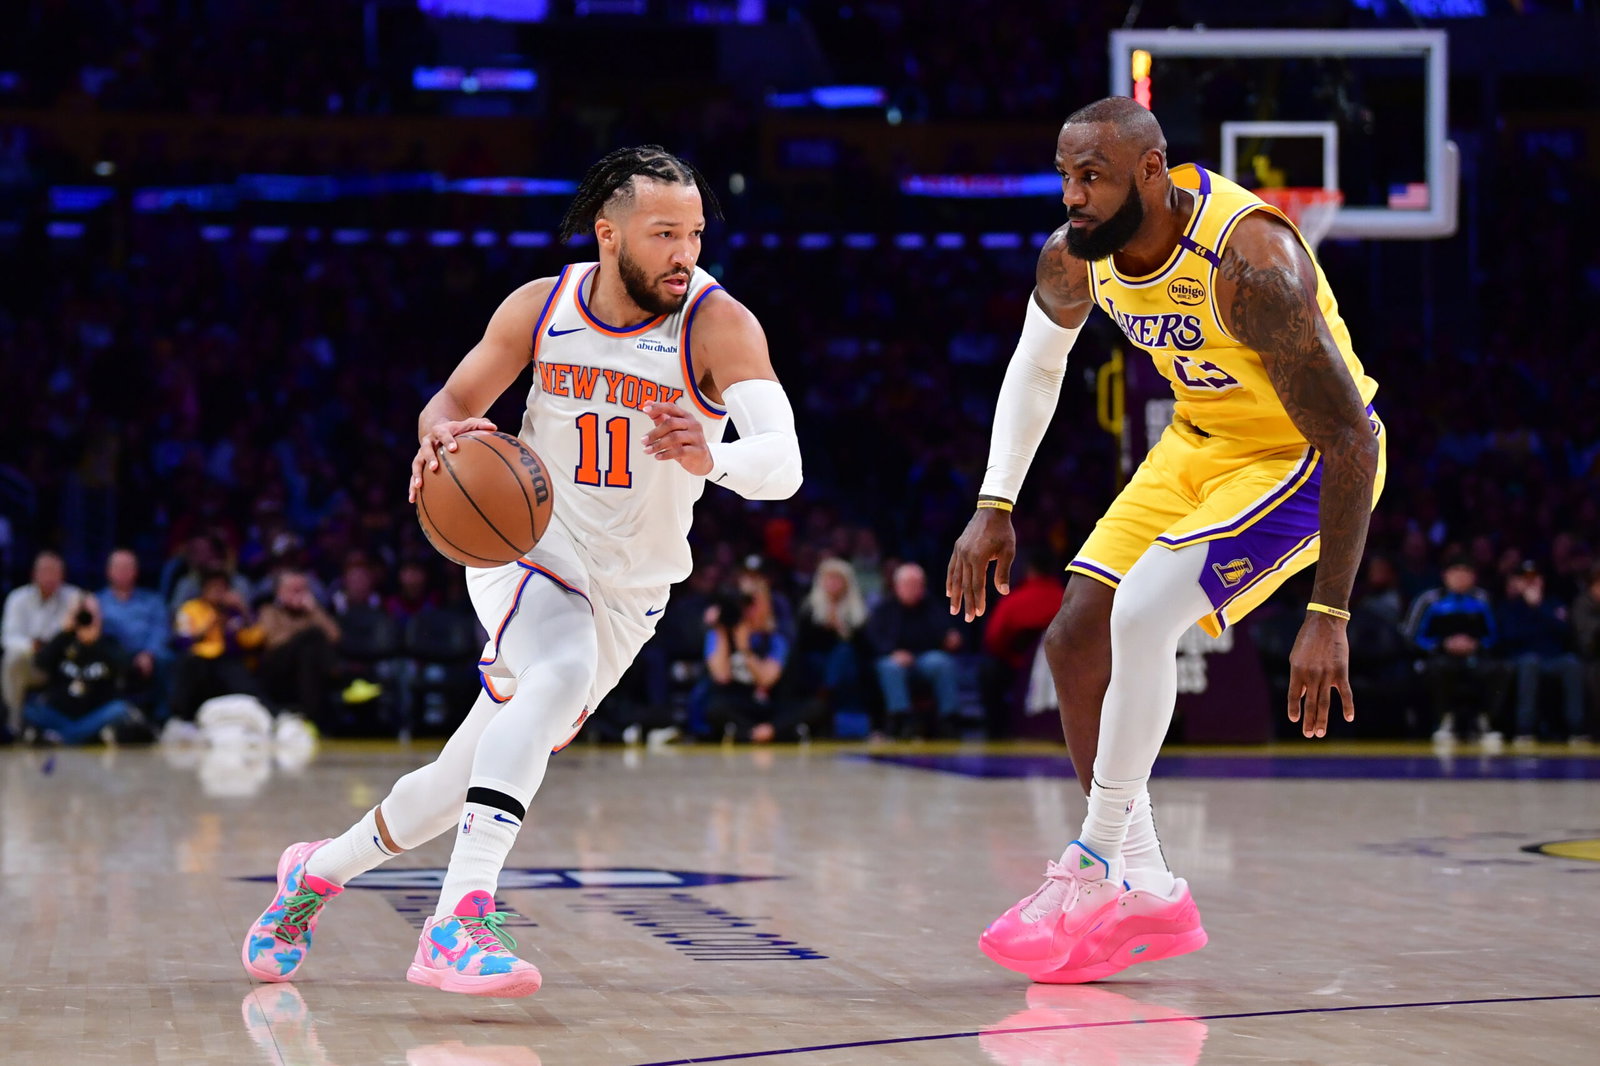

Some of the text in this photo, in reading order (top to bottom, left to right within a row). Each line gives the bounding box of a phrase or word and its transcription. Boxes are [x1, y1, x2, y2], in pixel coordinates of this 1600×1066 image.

[1195, 245, 1207, 257] 44
[1171, 284, 1204, 299] bibigo
[636, 343, 678, 353] abu dhabi
[539, 361, 600, 400] NEW
[574, 411, 632, 489] 11
